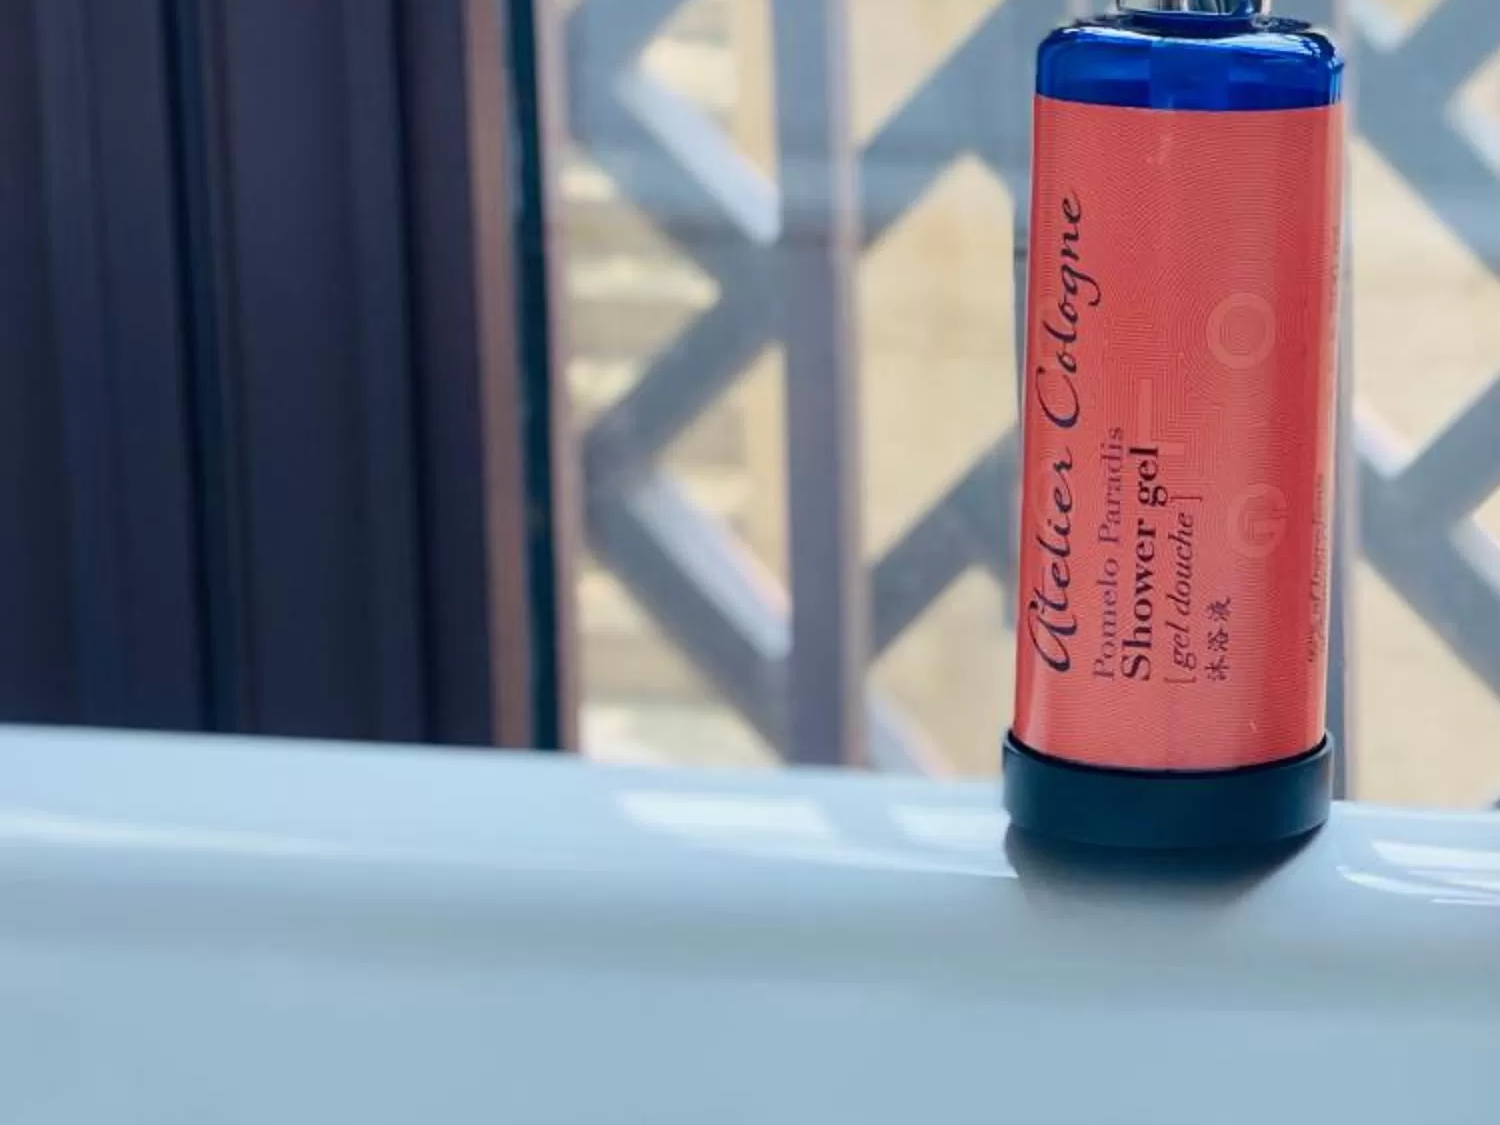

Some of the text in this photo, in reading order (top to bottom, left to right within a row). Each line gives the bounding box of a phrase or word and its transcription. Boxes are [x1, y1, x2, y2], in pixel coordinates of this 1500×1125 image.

[1028, 190, 1102, 673] Atelier Cologne
[1093, 427, 1124, 680] Pomelo Paradis
[1122, 446, 1168, 681] Shower gel
